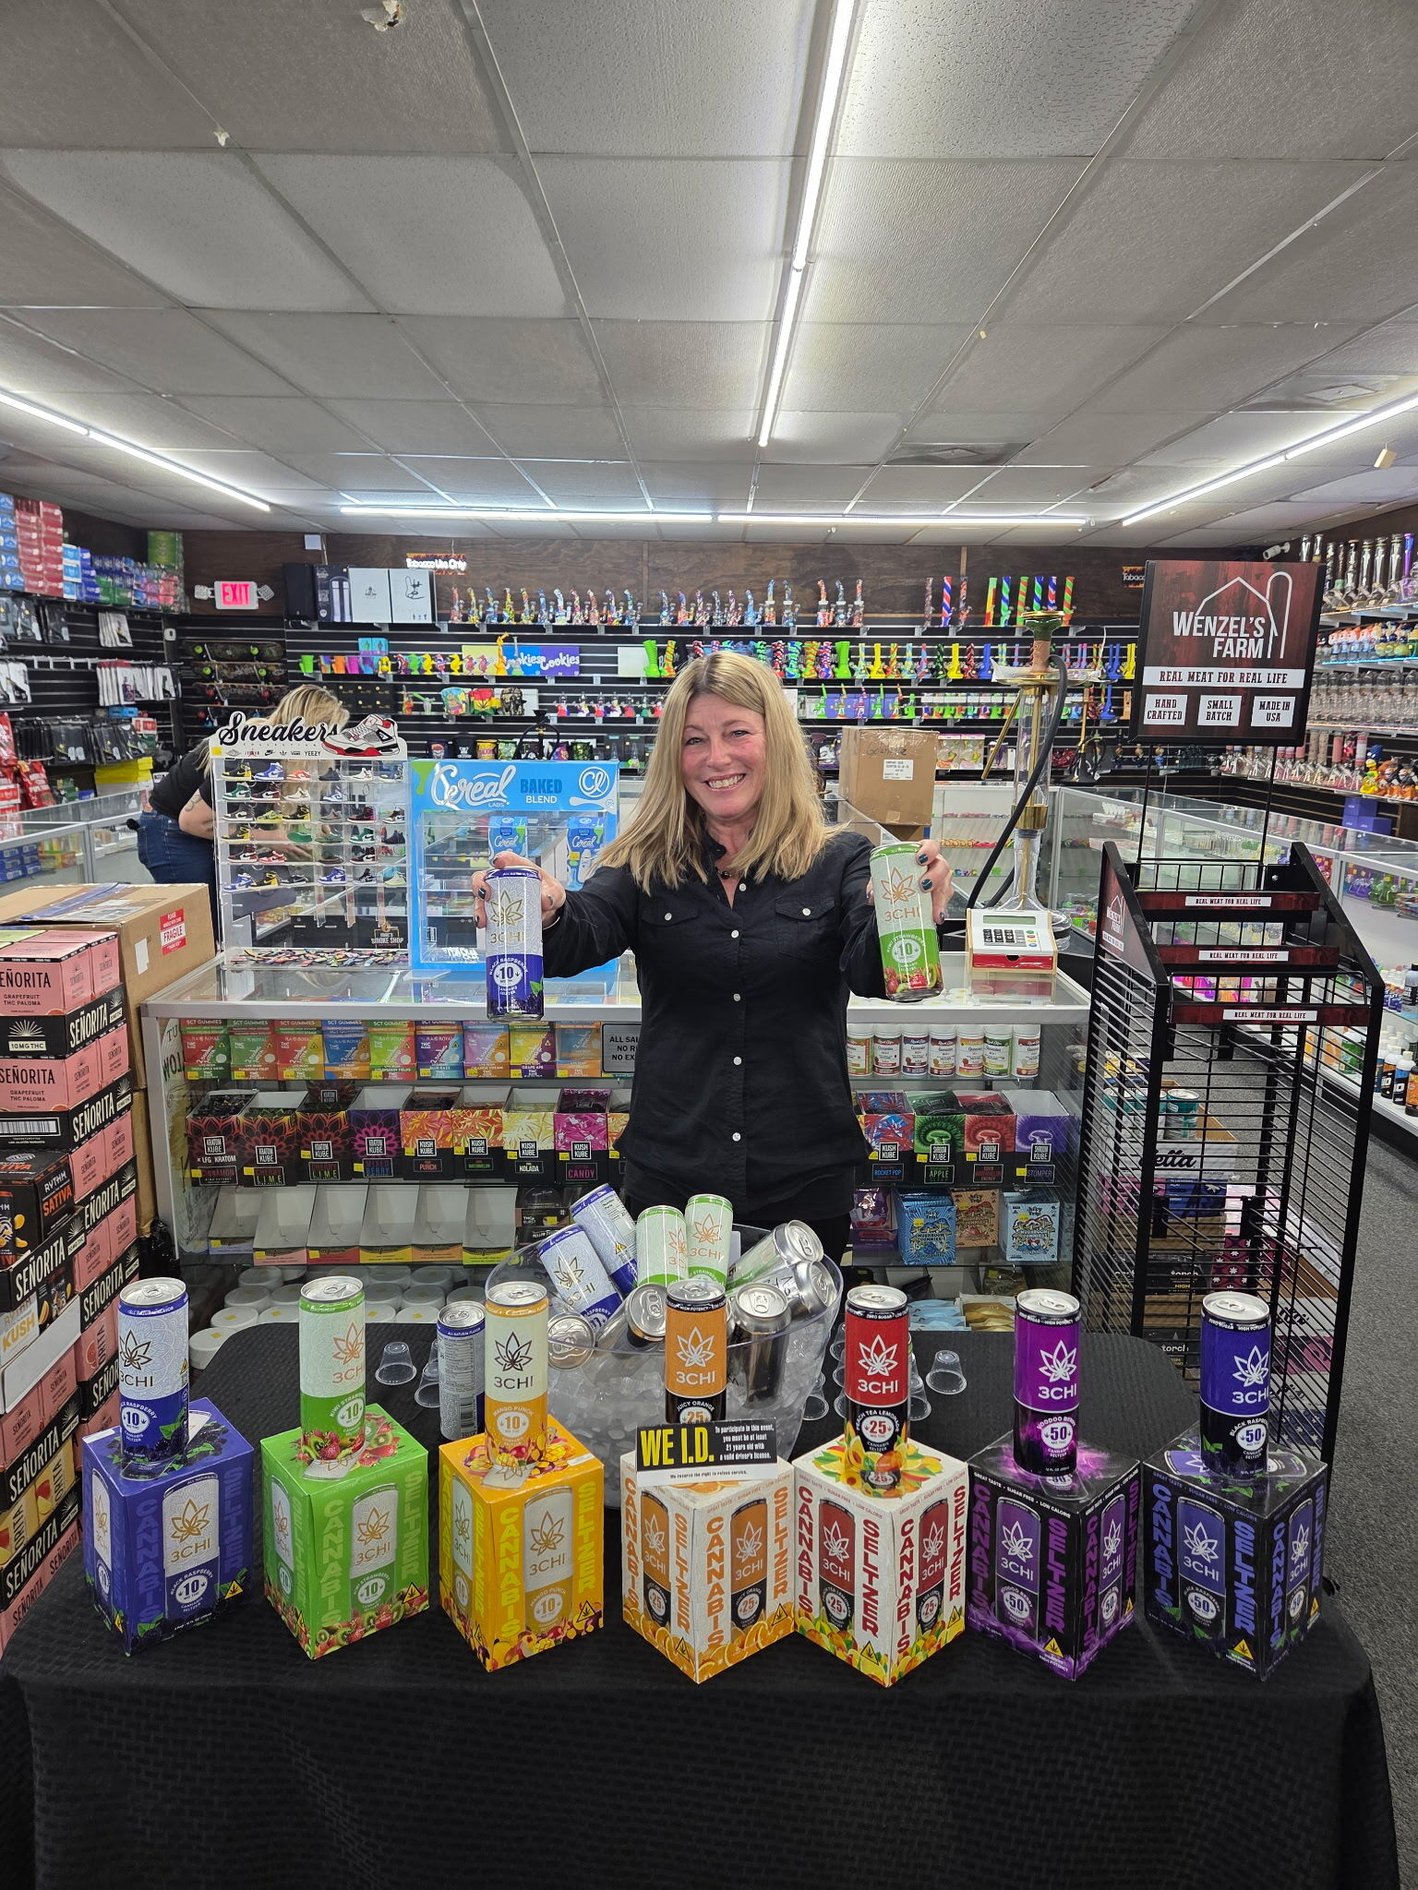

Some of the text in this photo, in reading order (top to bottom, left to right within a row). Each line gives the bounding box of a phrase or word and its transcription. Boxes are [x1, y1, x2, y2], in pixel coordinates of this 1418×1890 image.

[222, 583, 250, 605] EXIT
[1172, 611, 1266, 637] WENZEL'S
[1212, 638, 1264, 659] FARM
[540, 652, 580, 671] Cookies
[1159, 670, 1288, 684] REAL MEAT FOR REAL LIFE
[1155, 698, 1177, 709] HAND
[1207, 699, 1233, 710] SMALL
[1259, 700, 1291, 711] MADE IN
[1147, 709, 1183, 721] CRAFTED
[1206, 711, 1232, 721] BATCH
[1265, 711, 1281, 722] USA
[219, 711, 338, 746] Sneakers
[431, 764, 562, 810] Cereal BAKED
[526, 795, 557, 804] BLEND
[572, 835, 597, 849] Cereal
[883, 906, 921, 922] 3CHI
[163, 925, 183, 940] FRAGILE
[898, 942, 913, 954] 10
[0, 968, 52, 988] EÑORITA
[501, 966, 514, 979] 10
[1234, 1011, 1248, 1019] REAL
[69, 1002, 109, 1049] SEÑORITA
[612, 1053, 623, 1061] NO
[0, 1066, 56, 1085] SEÑORITA
[72, 1092, 115, 1143] SEÑORITA
[207, 1145, 222, 1153] KUBE
[315, 1150, 329, 1158] KUBE
[369, 1146, 383, 1154] KUBE
[521, 1149, 537, 1157] KUBE
[574, 1150, 589, 1158] KUBE
[932, 1152, 947, 1160] KUBE
[311, 1170, 337, 1179] LIME
[519, 1164, 540, 1172] KOLADA
[567, 1169, 596, 1180] CANDY
[929, 1170, 949, 1178] APPLE
[44, 1170, 67, 1193] RYTHM
[43, 1185, 73, 1216] SATIVA
[689, 1247, 722, 1260] 3CHI
[15, 1236, 66, 1302] SEÑORITA
[83, 1262, 124, 1322] SEÑORITA
[2, 1311, 36, 1351] KUSH
[493, 1375, 534, 1390] 3CHI
[676, 1370, 716, 1386] 3CHI
[857, 1378, 899, 1394] 3CHI
[1037, 1383, 1078, 1400] 3CHI
[1231, 1386, 1269, 1404] 3CHI
[345, 1402, 359, 1416] 10
[676, 1400, 715, 1412] JUICY ORANGE
[125, 1411, 140, 1426] 10
[504, 1415, 521, 1430] 10
[687, 1411, 704, 1422] 25
[721, 1425, 745, 1435] participate
[869, 1421, 887, 1434] 25
[1049, 1427, 1067, 1440] 50
[1246, 1429, 1261, 1442] 50
[640, 1426, 715, 1467] WE I.D.
[723, 1435, 731, 1443] you
[754, 1442, 765, 1450] with
[9, 1424, 60, 1502] SEÑORITA
[577, 1481, 598, 1593] SELTZER
[624, 1477, 640, 1611] CANNABIS
[773, 1486, 788, 1600] SELTZER
[949, 1485, 966, 1602] SELTZER
[50, 1530, 79, 1576] SEÑORITA
[170, 1538, 211, 1563] 3CHI
[356, 1541, 391, 1566] 3CHI
[798, 1486, 814, 1617] CANNABIS
[972, 1483, 991, 1610] CANNABIS
[1152, 1483, 1174, 1609] CANNABIS
[6, 1517, 59, 1600] SEÑORITA
[320, 1499, 345, 1627] CANNABIS
[529, 1552, 566, 1576] 3CHI
[643, 1551, 666, 1575] 3CHI
[1102, 1553, 1121, 1580] 3CHI
[499, 1506, 521, 1639] CANNABIS
[674, 1512, 690, 1635] SELTZER
[735, 1557, 764, 1581] 3CHI
[822, 1557, 850, 1582] 3CHI
[921, 1556, 945, 1581] 3CHI
[1000, 1557, 1034, 1582] 3CHI
[1045, 1517, 1068, 1635] SELTZER
[1183, 1555, 1219, 1583] 3CHI
[1289, 1557, 1309, 1583] 3CHI
[183, 1579, 200, 1595] 10
[706, 1516, 725, 1651] CANNABIS
[862, 1518, 880, 1639] SELTZER
[897, 1518, 915, 1654] CANNABIS
[1083, 1514, 1099, 1649] CANNABIS
[1233, 1520, 1256, 1638] SELTZER
[1270, 1521, 1286, 1650] CANNABIS
[365, 1582, 379, 1596] 10
[13, 1576, 45, 1628] SEÑORITA
[541, 1597, 556, 1612] 10
[742, 1597, 755, 1610] 25
[829, 1595, 842, 1609] 25
[923, 1599, 935, 1612] 25
[1009, 1595, 1025, 1611] 50
[1192, 1595, 1210, 1611] 50
